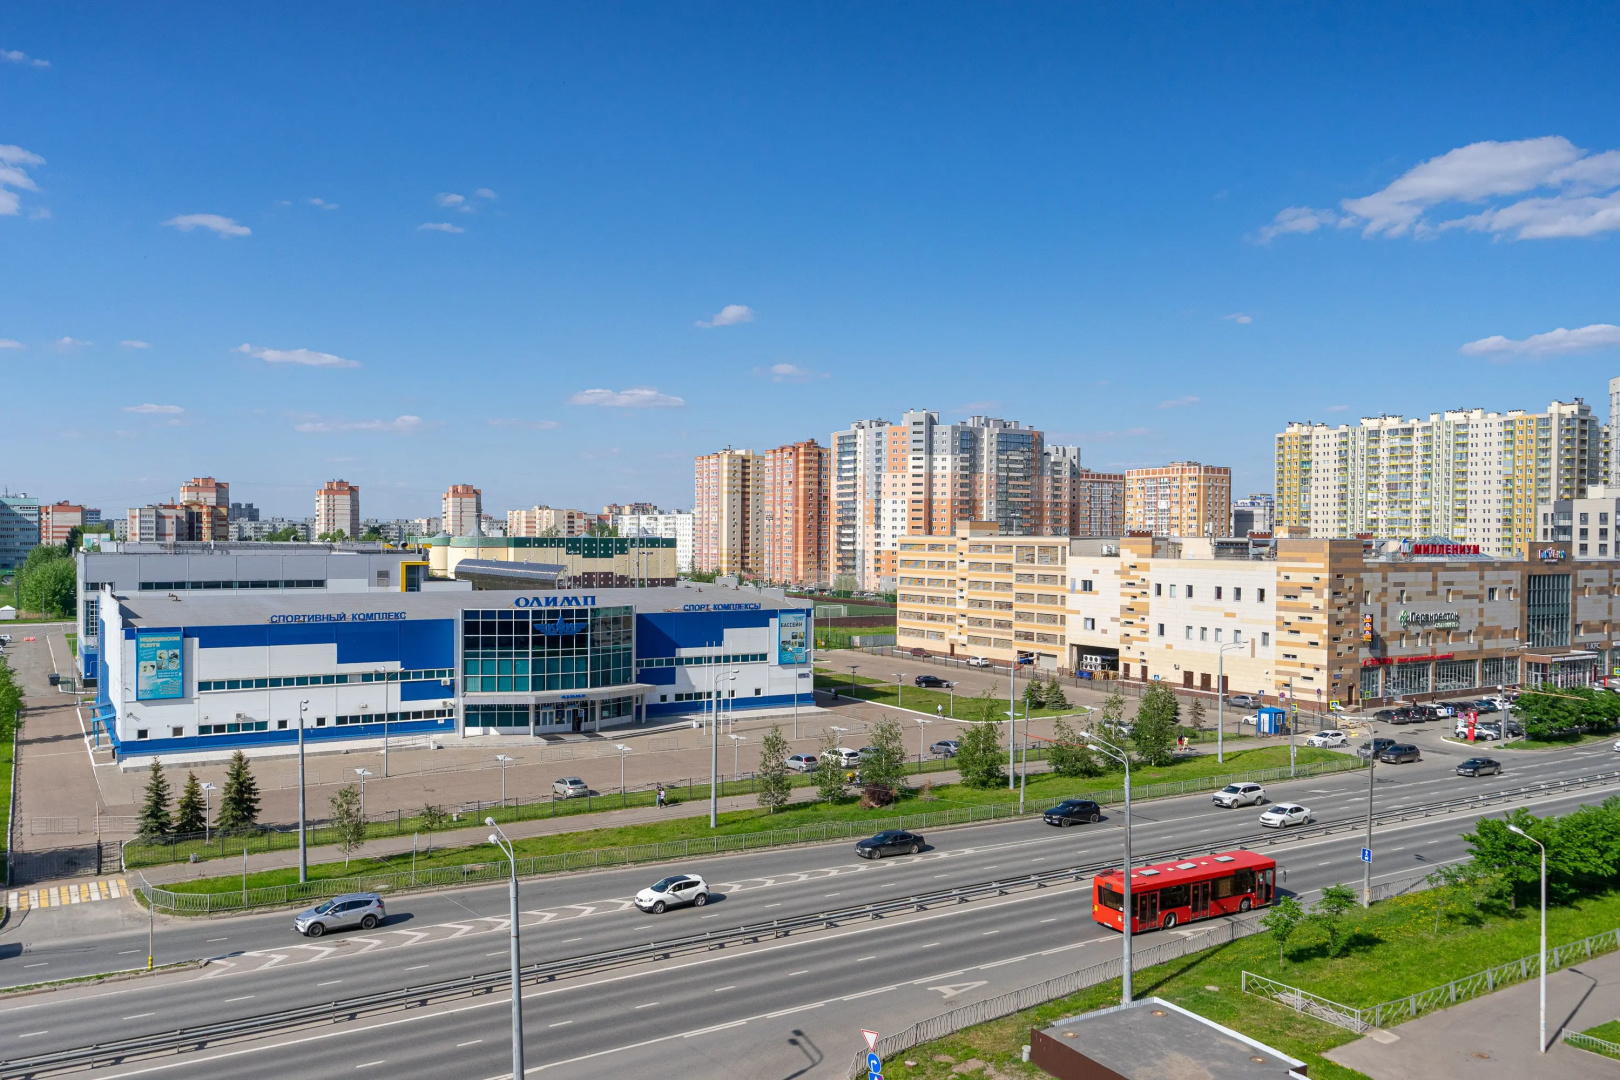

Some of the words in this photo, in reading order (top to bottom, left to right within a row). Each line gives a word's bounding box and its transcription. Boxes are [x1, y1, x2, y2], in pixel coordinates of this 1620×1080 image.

[1413, 544, 1480, 555] МИЛЛЕНИУМ
[514, 595, 597, 608] ОЛИМП
[683, 604, 710, 612] СПОРТ
[712, 602, 762, 610] КОМПЛЕКСЫ
[270, 612, 346, 623] СПОРТИВНЫЙ
[351, 611, 407, 621] КОМПЛЕКС
